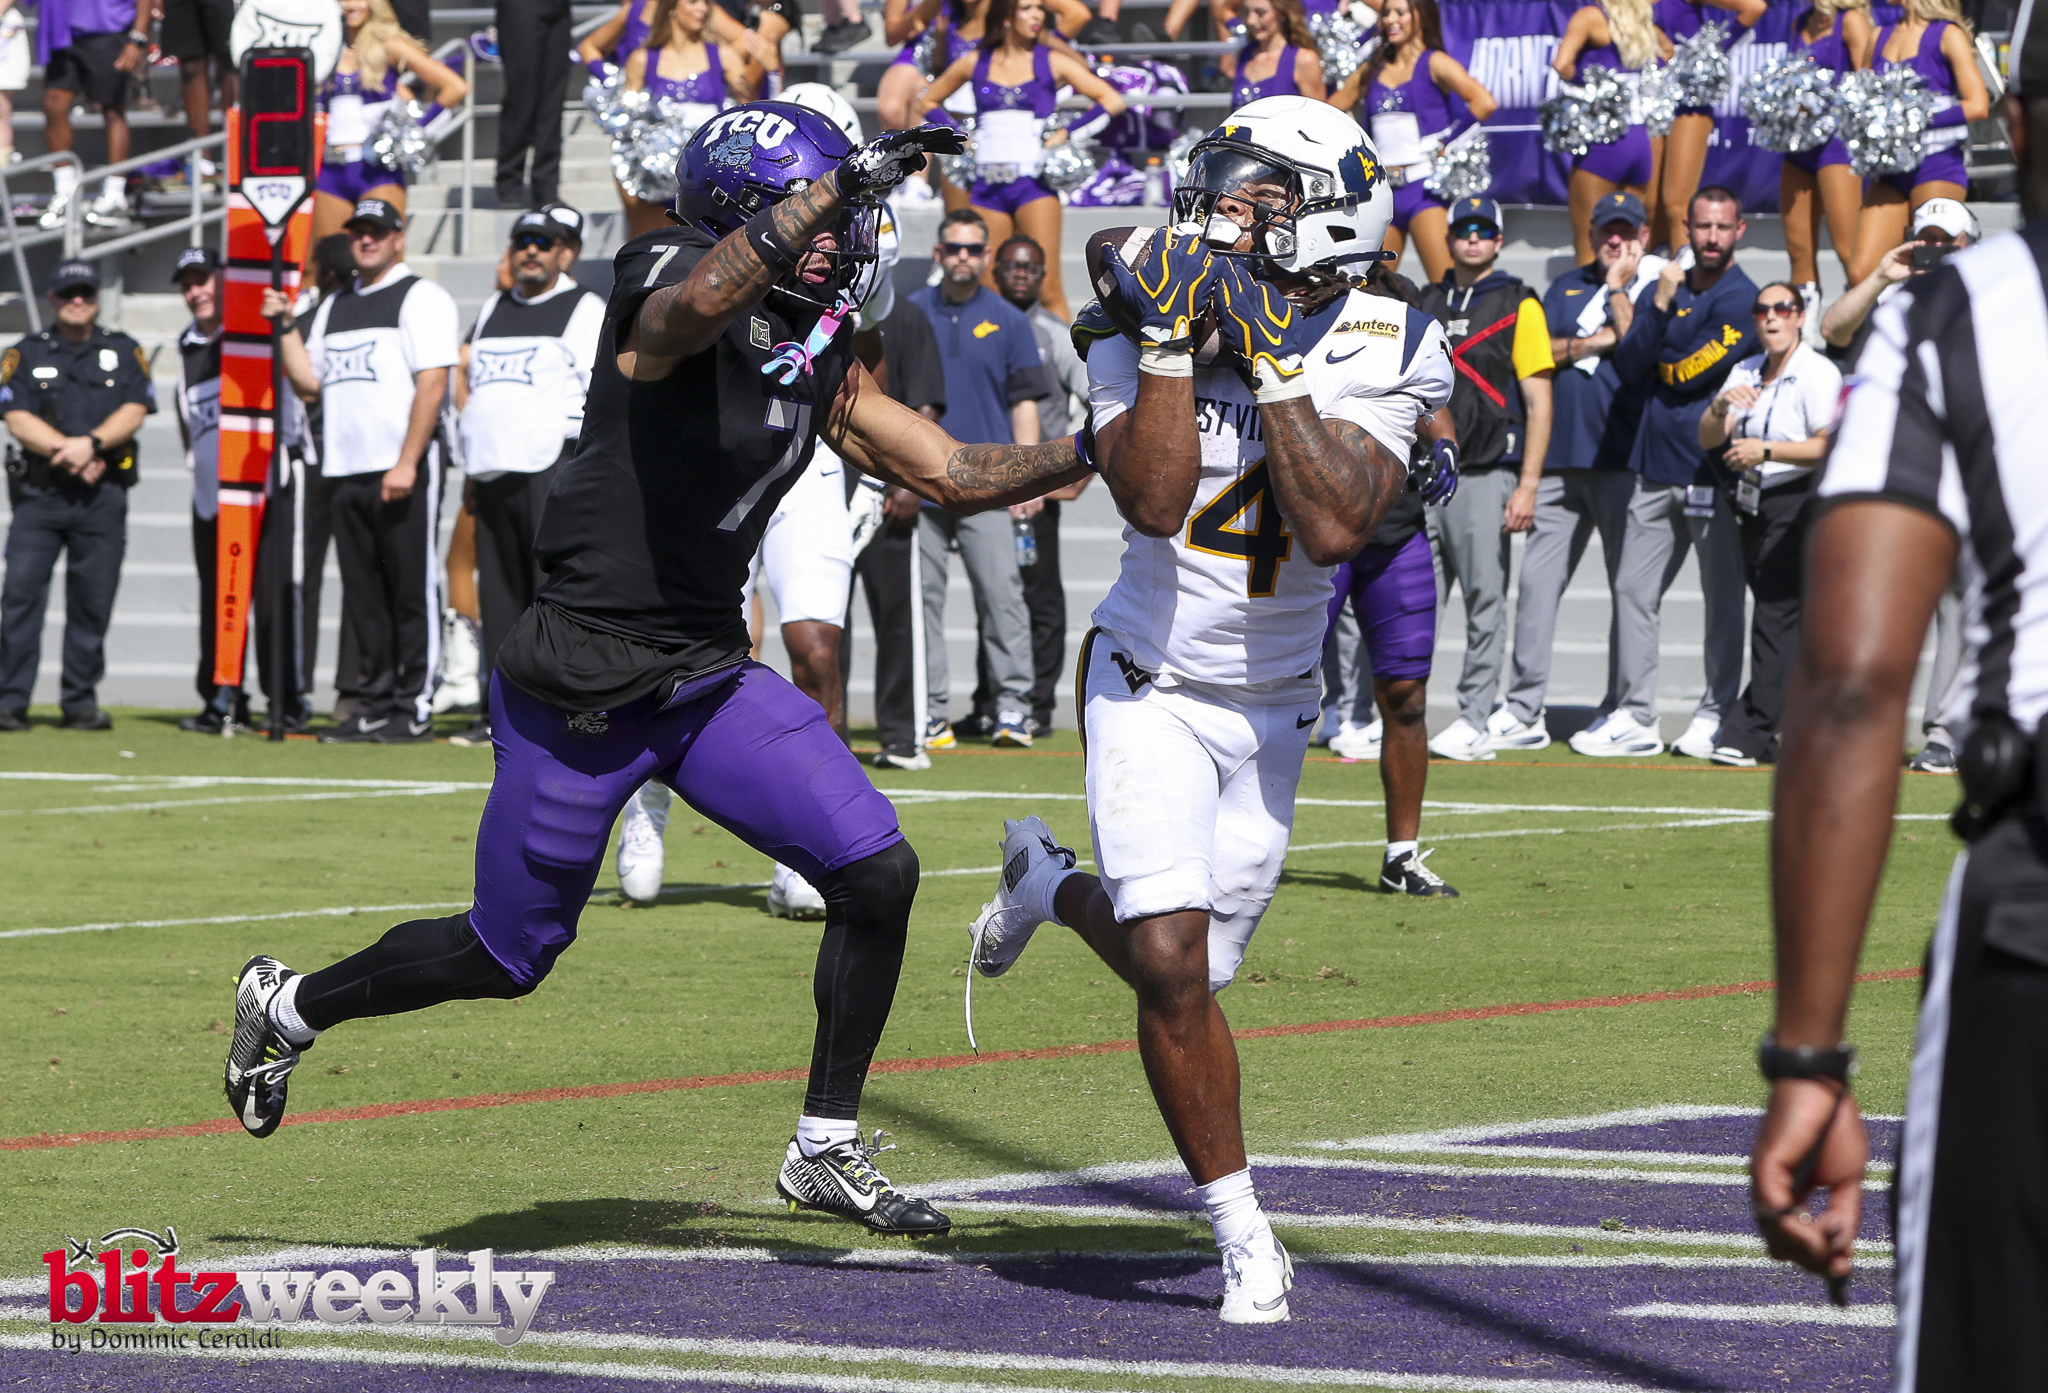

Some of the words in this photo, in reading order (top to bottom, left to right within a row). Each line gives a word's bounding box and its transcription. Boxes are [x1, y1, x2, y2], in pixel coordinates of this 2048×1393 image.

[250, 58, 306, 176] 2
[703, 110, 796, 150] TCU
[257, 183, 291, 200] TCU
[644, 245, 680, 287] 7
[1351, 319, 1399, 333] Antero
[717, 397, 812, 532] 7
[1185, 455, 1293, 598] 4
